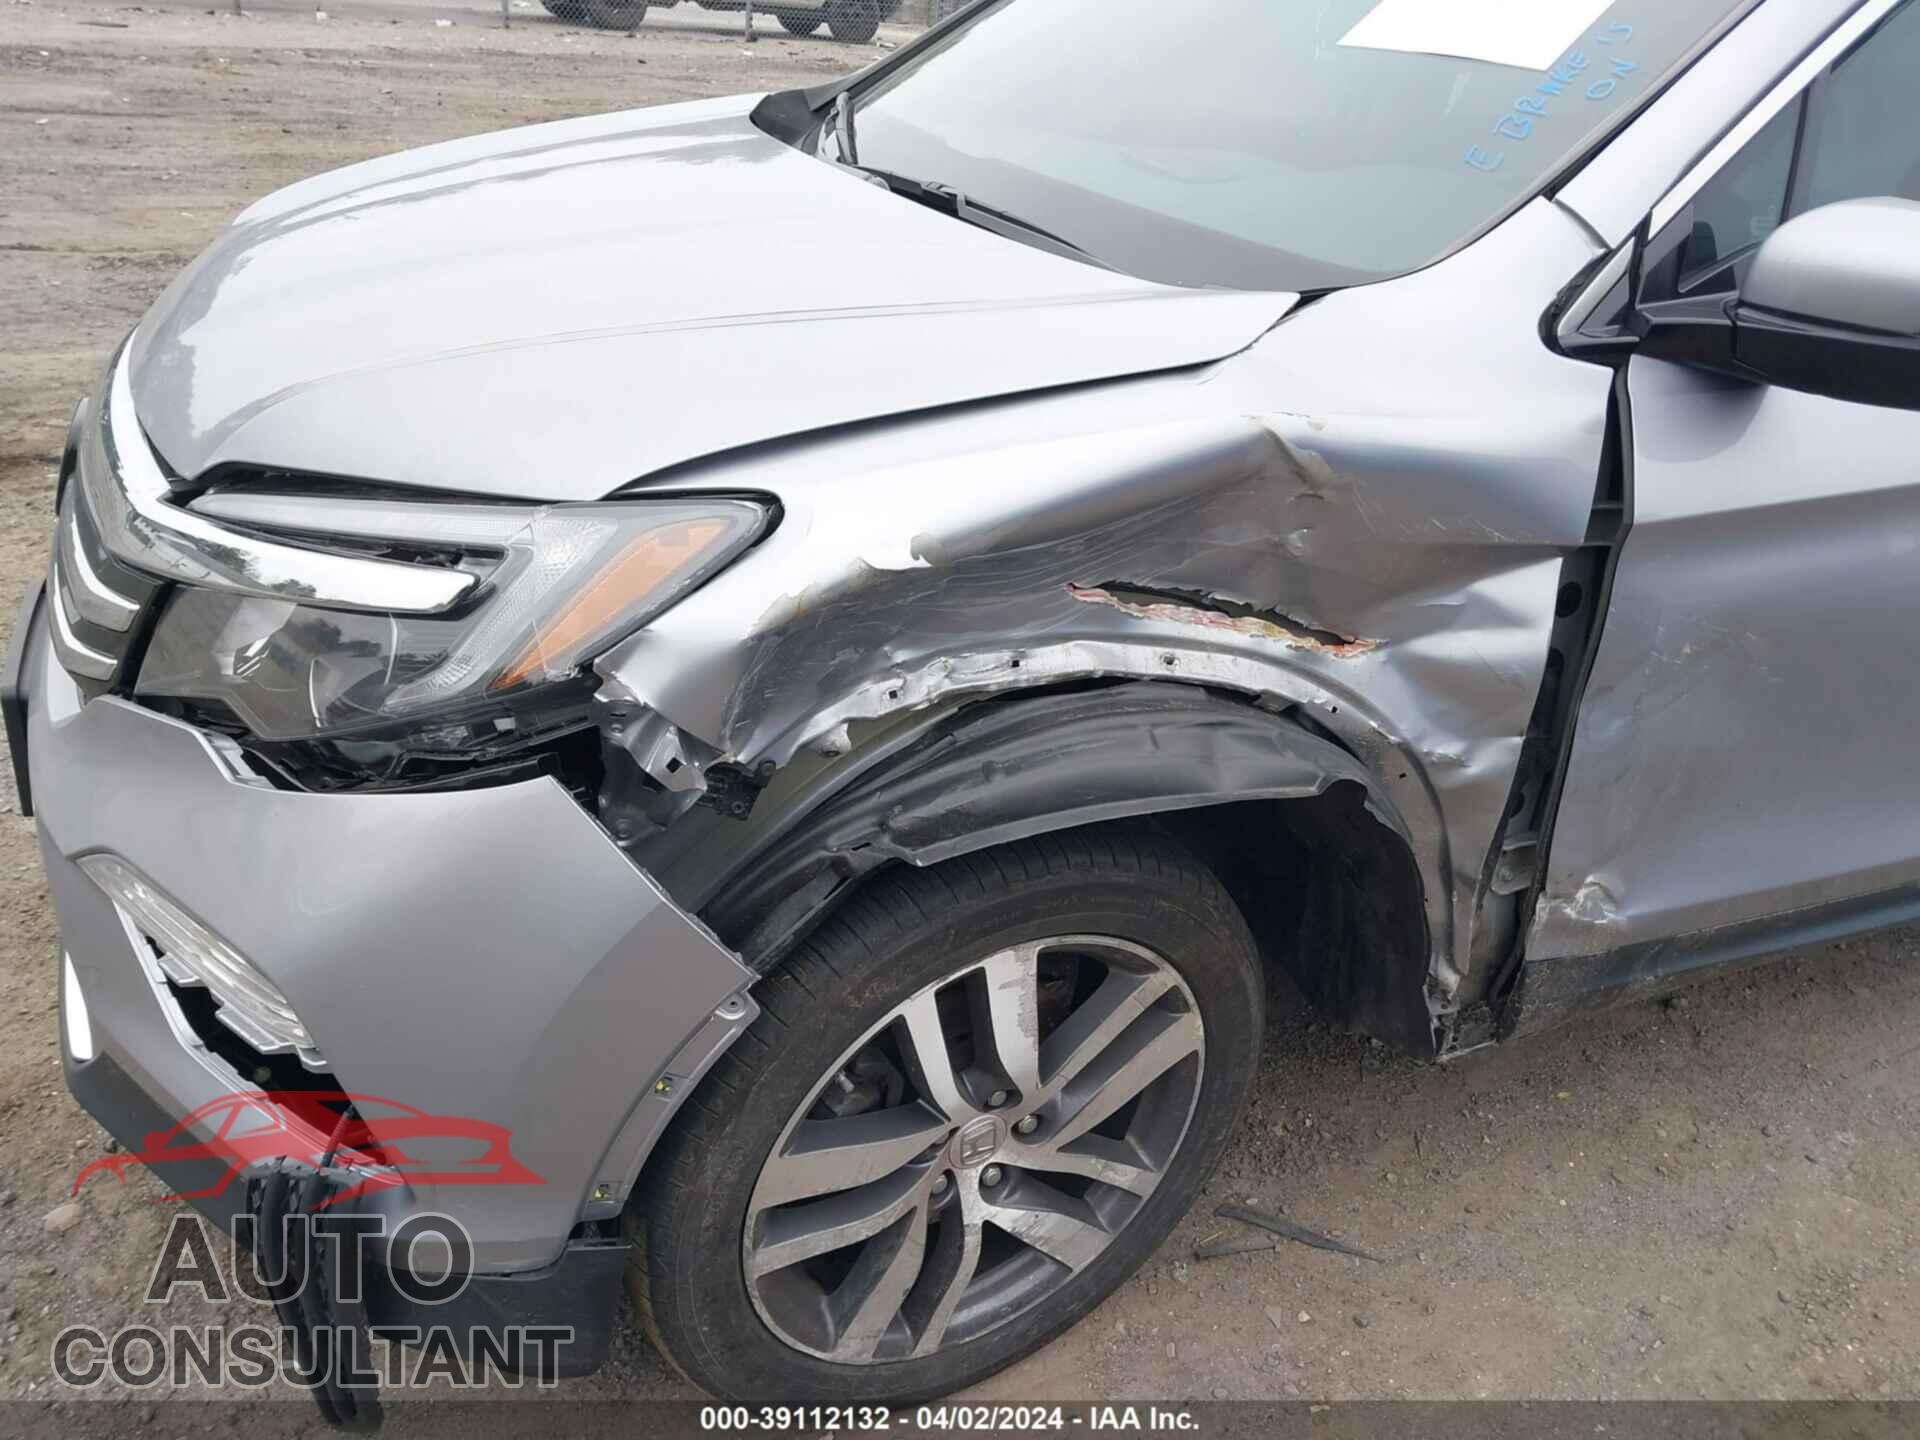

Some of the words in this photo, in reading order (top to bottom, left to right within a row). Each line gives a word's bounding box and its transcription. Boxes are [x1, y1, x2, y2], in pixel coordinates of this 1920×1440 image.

[1464, 145, 1503, 171] E
[1596, 19, 1633, 46] IS
[1585, 57, 1639, 100] ON
